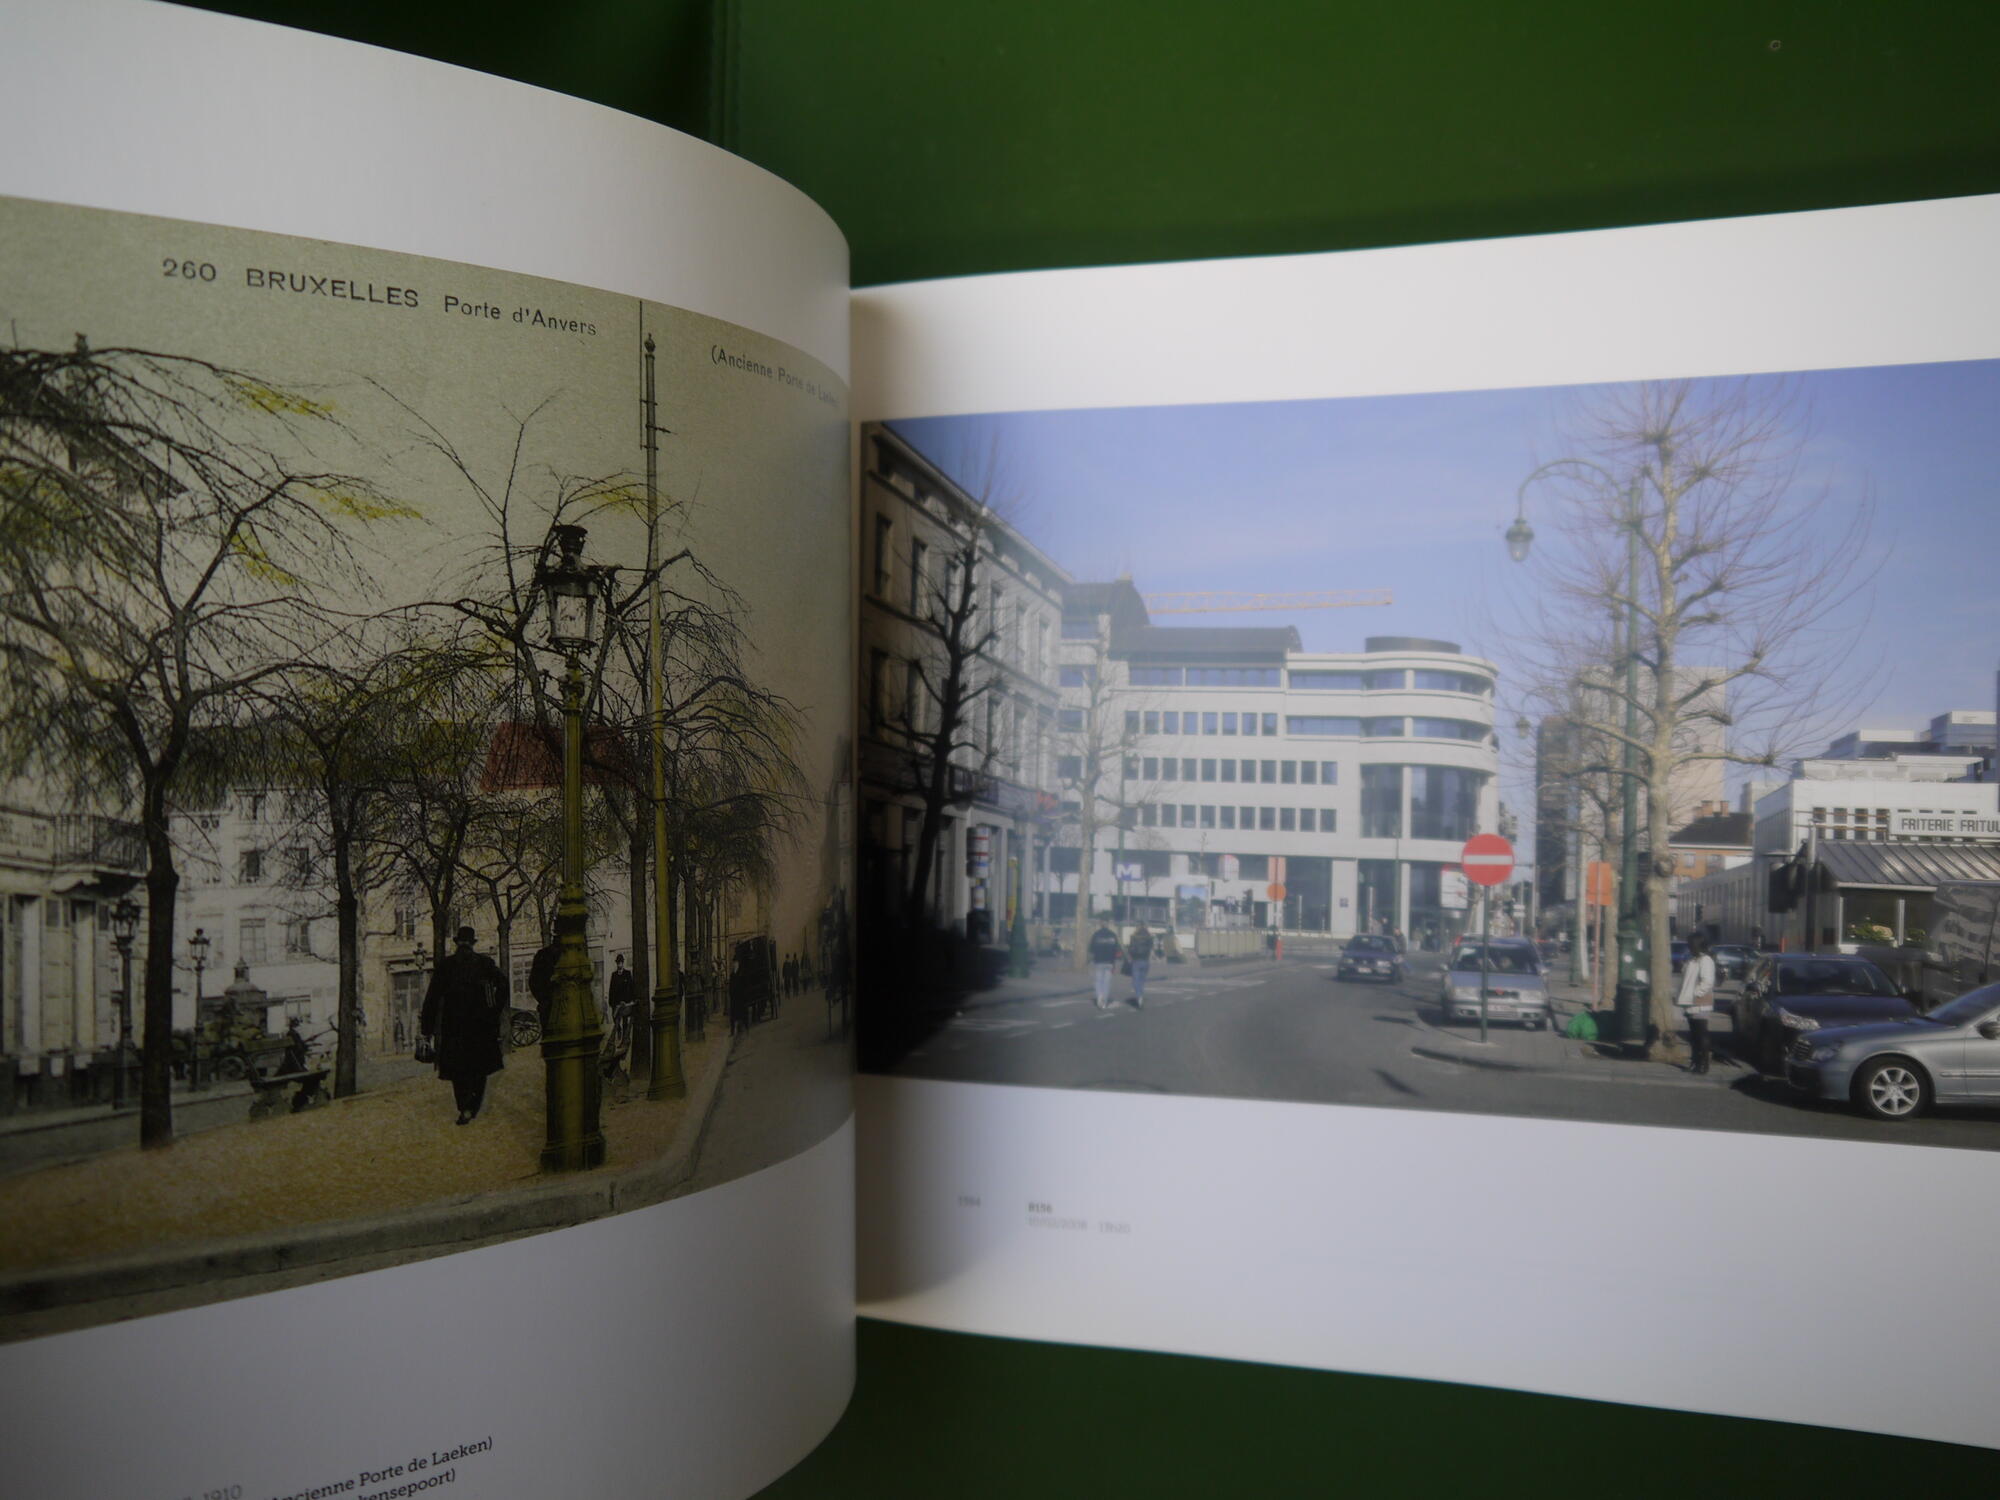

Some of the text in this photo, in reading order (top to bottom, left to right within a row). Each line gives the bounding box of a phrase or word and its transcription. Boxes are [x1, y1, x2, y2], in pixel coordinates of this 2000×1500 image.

[162, 258, 598, 337] 260 BRUXELLES Porte d'Anvers
[711, 344, 773, 378] (Ancienne
[1901, 818, 1954, 832] FRITERIE
[264, 1435, 493, 1500] cienne Porte de Laeken)
